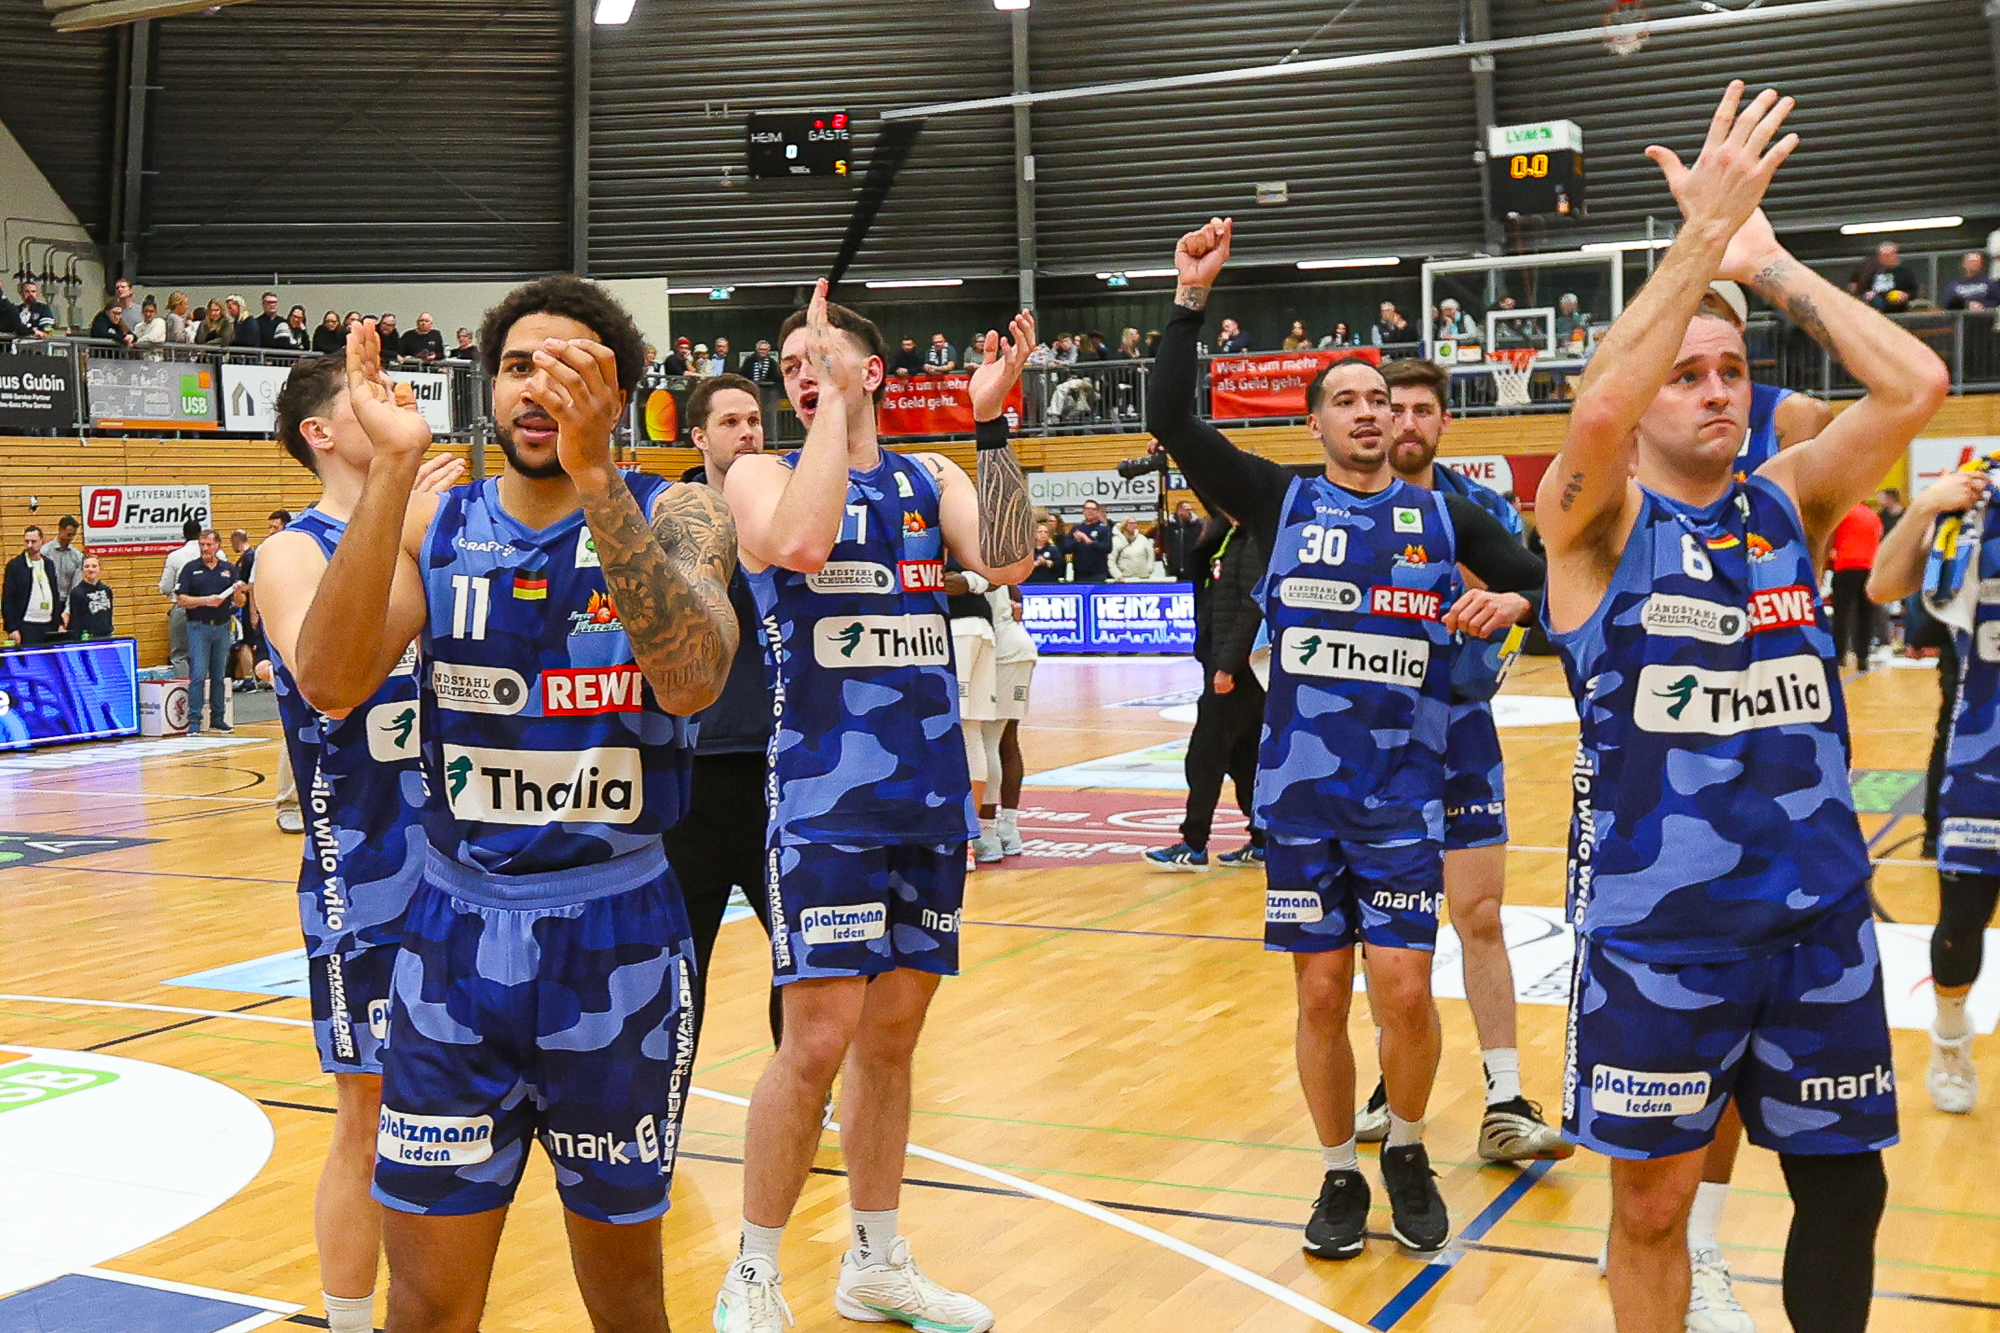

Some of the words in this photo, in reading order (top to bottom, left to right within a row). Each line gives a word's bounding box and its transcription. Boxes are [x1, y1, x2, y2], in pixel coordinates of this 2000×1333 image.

[751, 132, 783, 143] HEIM
[808, 129, 850, 141] GÄSTE
[785, 144, 798, 159] 0
[835, 160, 848, 175] 5
[1511, 154, 1549, 179] 0.0
[1216, 359, 1256, 373] Weil's
[1258, 360, 1280, 371] um
[1283, 357, 1318, 370] mehr
[0, 376, 20, 389] us
[23, 373, 65, 392] Gubin
[916, 382, 934, 391] um
[937, 379, 969, 391] mehr
[1217, 379, 1236, 392] als
[1238, 377, 1269, 391] Geld
[182, 397, 208, 414] USB
[899, 397, 926, 410] Geld
[1450, 462, 1496, 479] EWE
[127, 490, 206, 500] LIFTVERMIETUNG
[1031, 477, 1156, 500] alphabytes
[125, 503, 207, 523] Franke
[457, 538, 504, 553] CRAFT
[1298, 524, 1348, 567] 30
[452, 574, 490, 641] 11
[1097, 597, 1160, 619] HEINZ
[1165, 596, 1195, 619] JA
[1373, 589, 1440, 619] REWE
[1327, 643, 1425, 679] Thalia
[435, 673, 491, 688] NDSTAHL
[436, 684, 492, 699] ULTE&CO.
[546, 671, 642, 710] REW
[1703, 673, 1821, 723] Thalia
[481, 767, 632, 811] Thalia
[1577, 798, 1598, 861] wilo
[313, 817, 340, 873] wilo
[323, 875, 347, 931] wilo
[769, 847, 792, 968] EICHWALDER
[1267, 894, 1318, 909] zmann
[1371, 890, 1433, 915] mark
[804, 908, 883, 932] platzmann
[1594, 1071, 1706, 1096] platzmann
[1801, 1064, 1892, 1102] mark
[1626, 1099, 1673, 1114] federn
[400, 1144, 451, 1161] federn
[548, 1129, 631, 1165] mark
